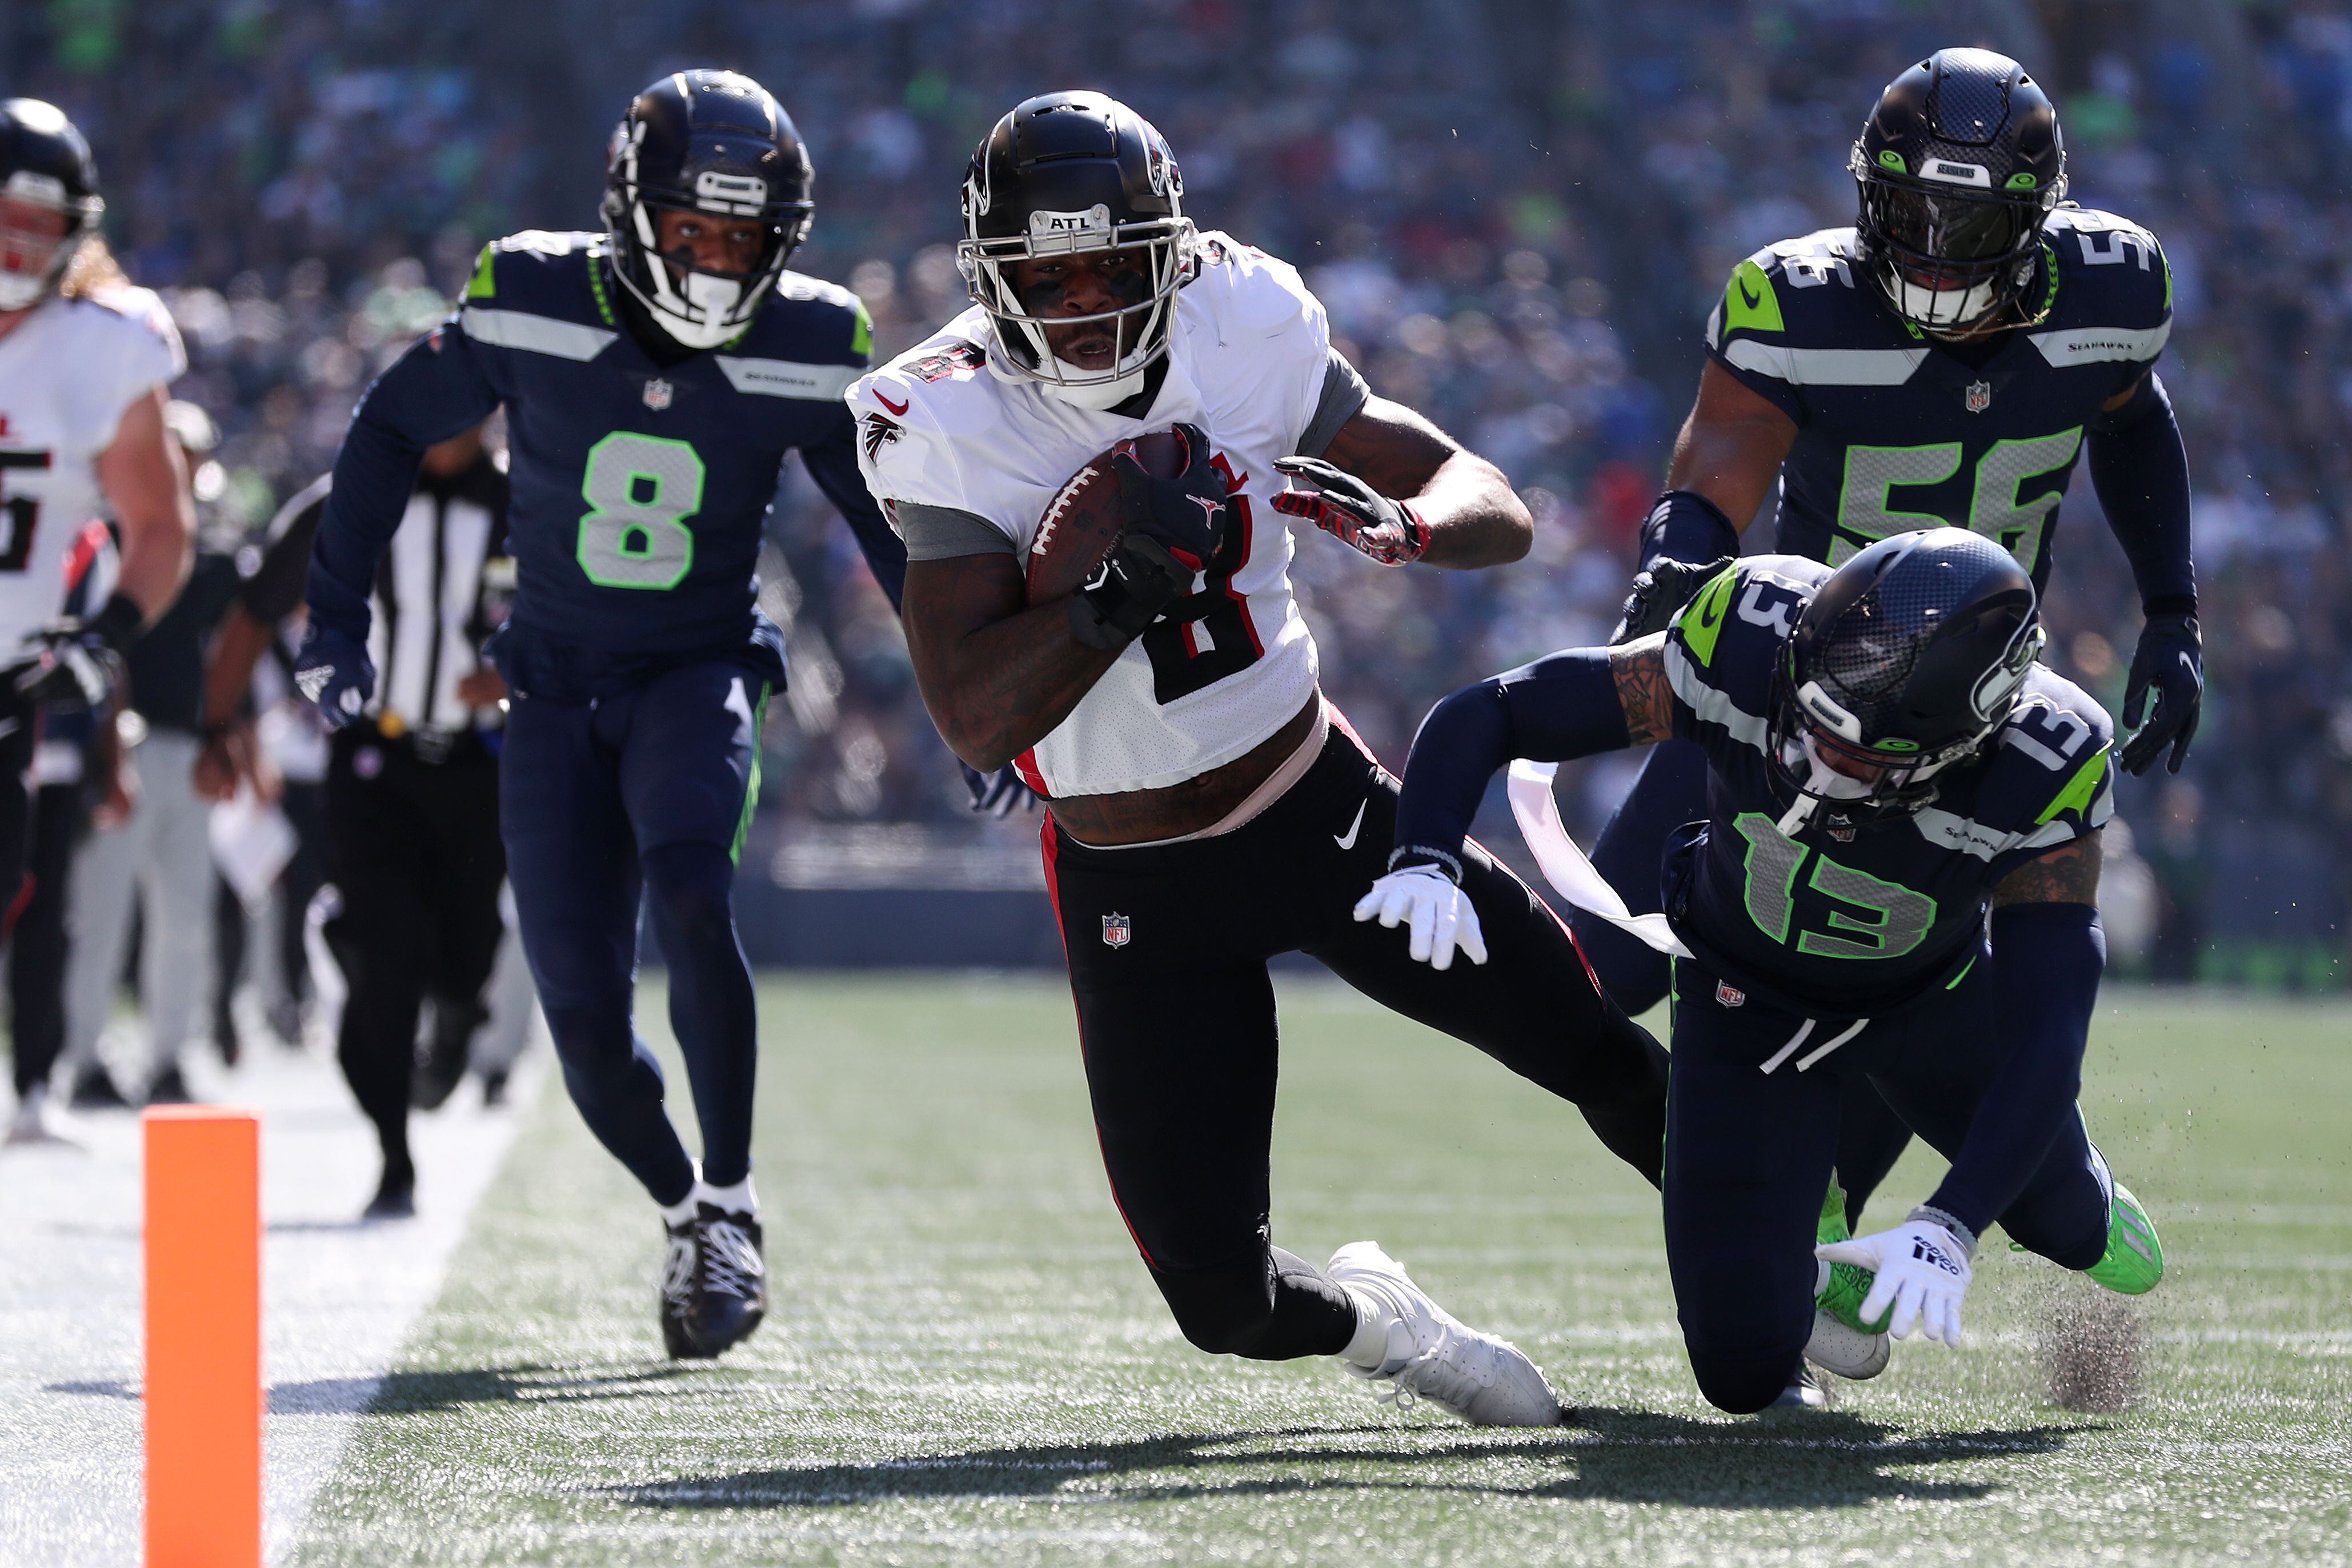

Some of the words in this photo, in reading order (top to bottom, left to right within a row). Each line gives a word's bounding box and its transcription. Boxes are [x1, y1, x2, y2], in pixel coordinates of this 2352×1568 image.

[1051, 218, 1090, 229] ATL
[2067, 341, 2133, 352] SEAHAWKS
[575, 430, 707, 591] 8
[1825, 424, 2084, 576] 56
[1998, 692, 2092, 772] 13
[1732, 812, 1938, 960] 13
[1107, 928, 1127, 942] NFL
